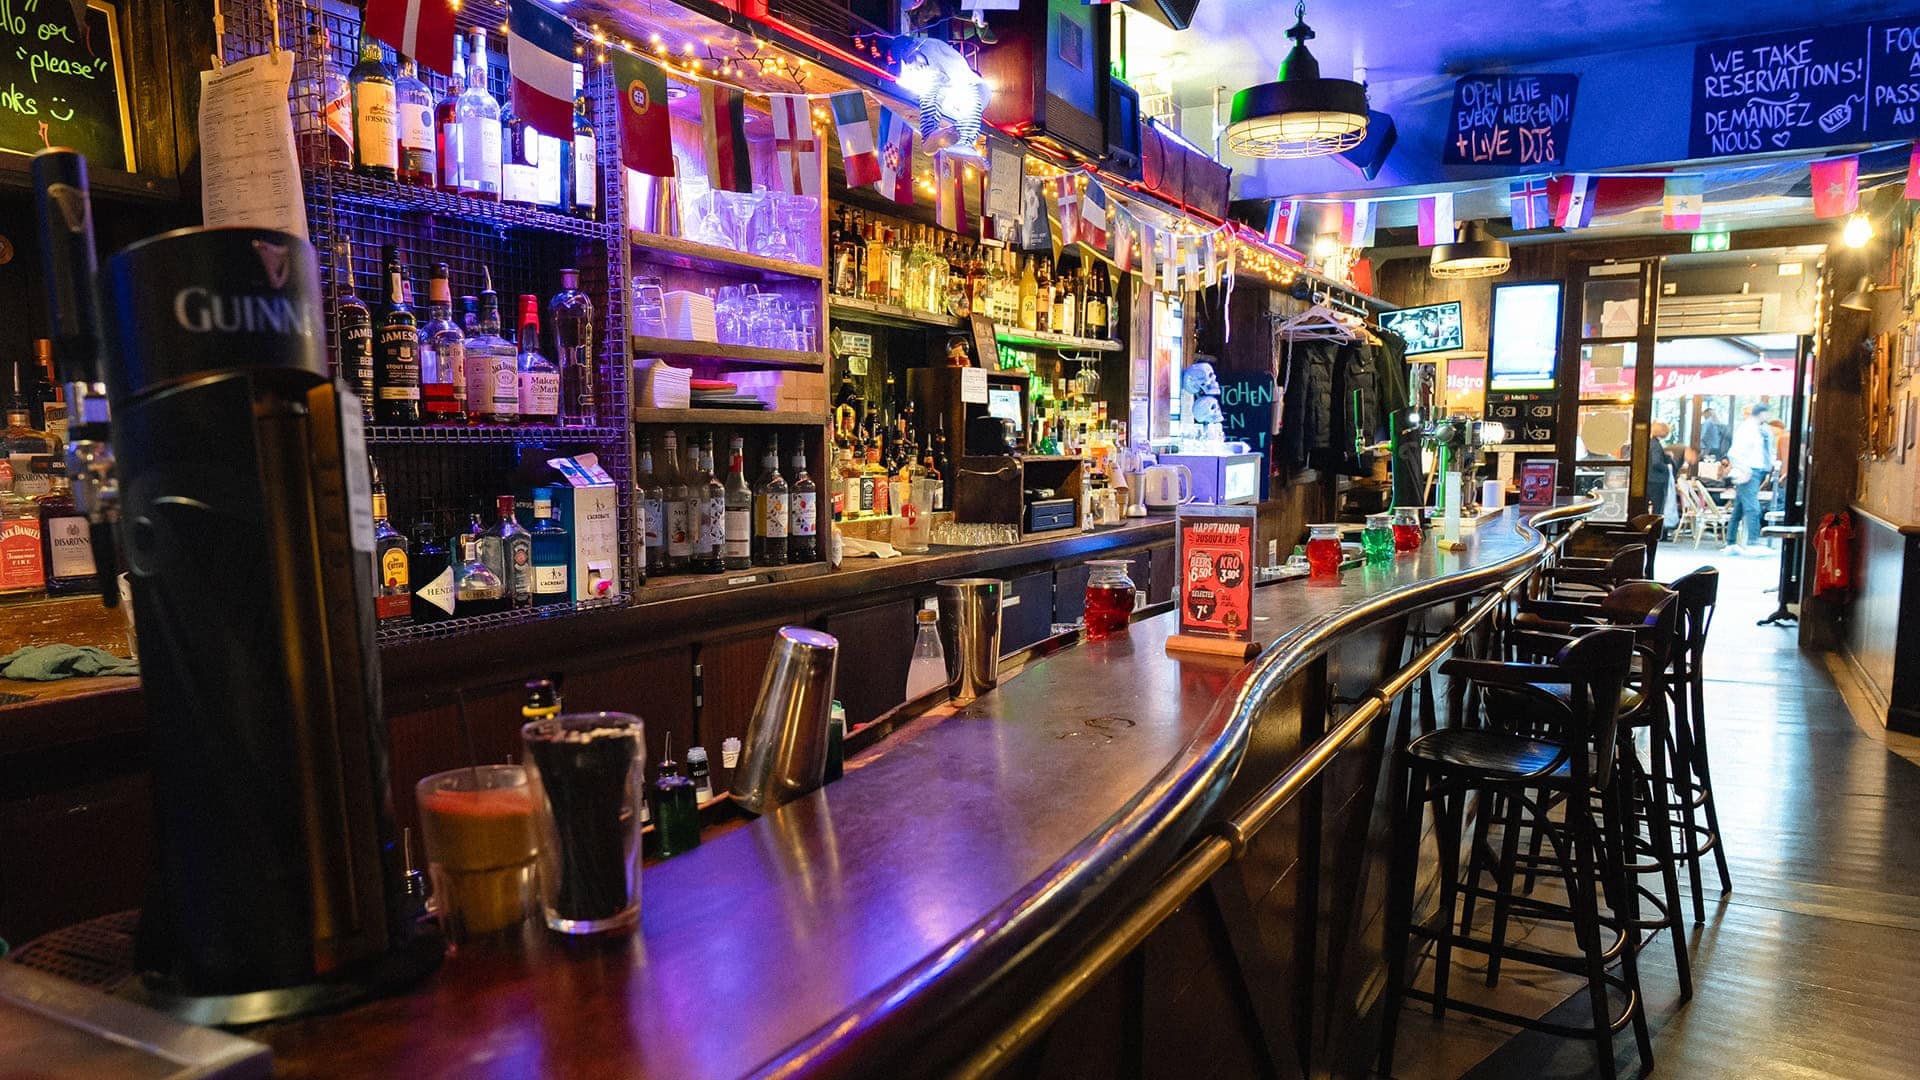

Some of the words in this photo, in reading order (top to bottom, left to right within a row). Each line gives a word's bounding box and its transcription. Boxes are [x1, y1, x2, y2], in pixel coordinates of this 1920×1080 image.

[38, 23, 75, 43] or
[1710, 50, 1745, 72] WE
[1752, 39, 1814, 69] TAKE
[1462, 77, 1501, 109] OPEN
[1507, 77, 1541, 103] LATE
[1704, 57, 1863, 98] RESERVATIONS!
[1458, 107, 1499, 131] EVERY
[1504, 93, 1569, 127] WEEK-END!
[1705, 102, 1814, 134] DEMANDEZ
[1822, 107, 1844, 126] VIP
[1892, 107, 1915, 125] AU
[1471, 124, 1512, 162] LIVE
[1711, 129, 1762, 153] NOUS
[1193, 522, 1218, 533] HAPPY
[1218, 523, 1240, 534] HOUR
[1220, 556, 1240, 569] KRO
